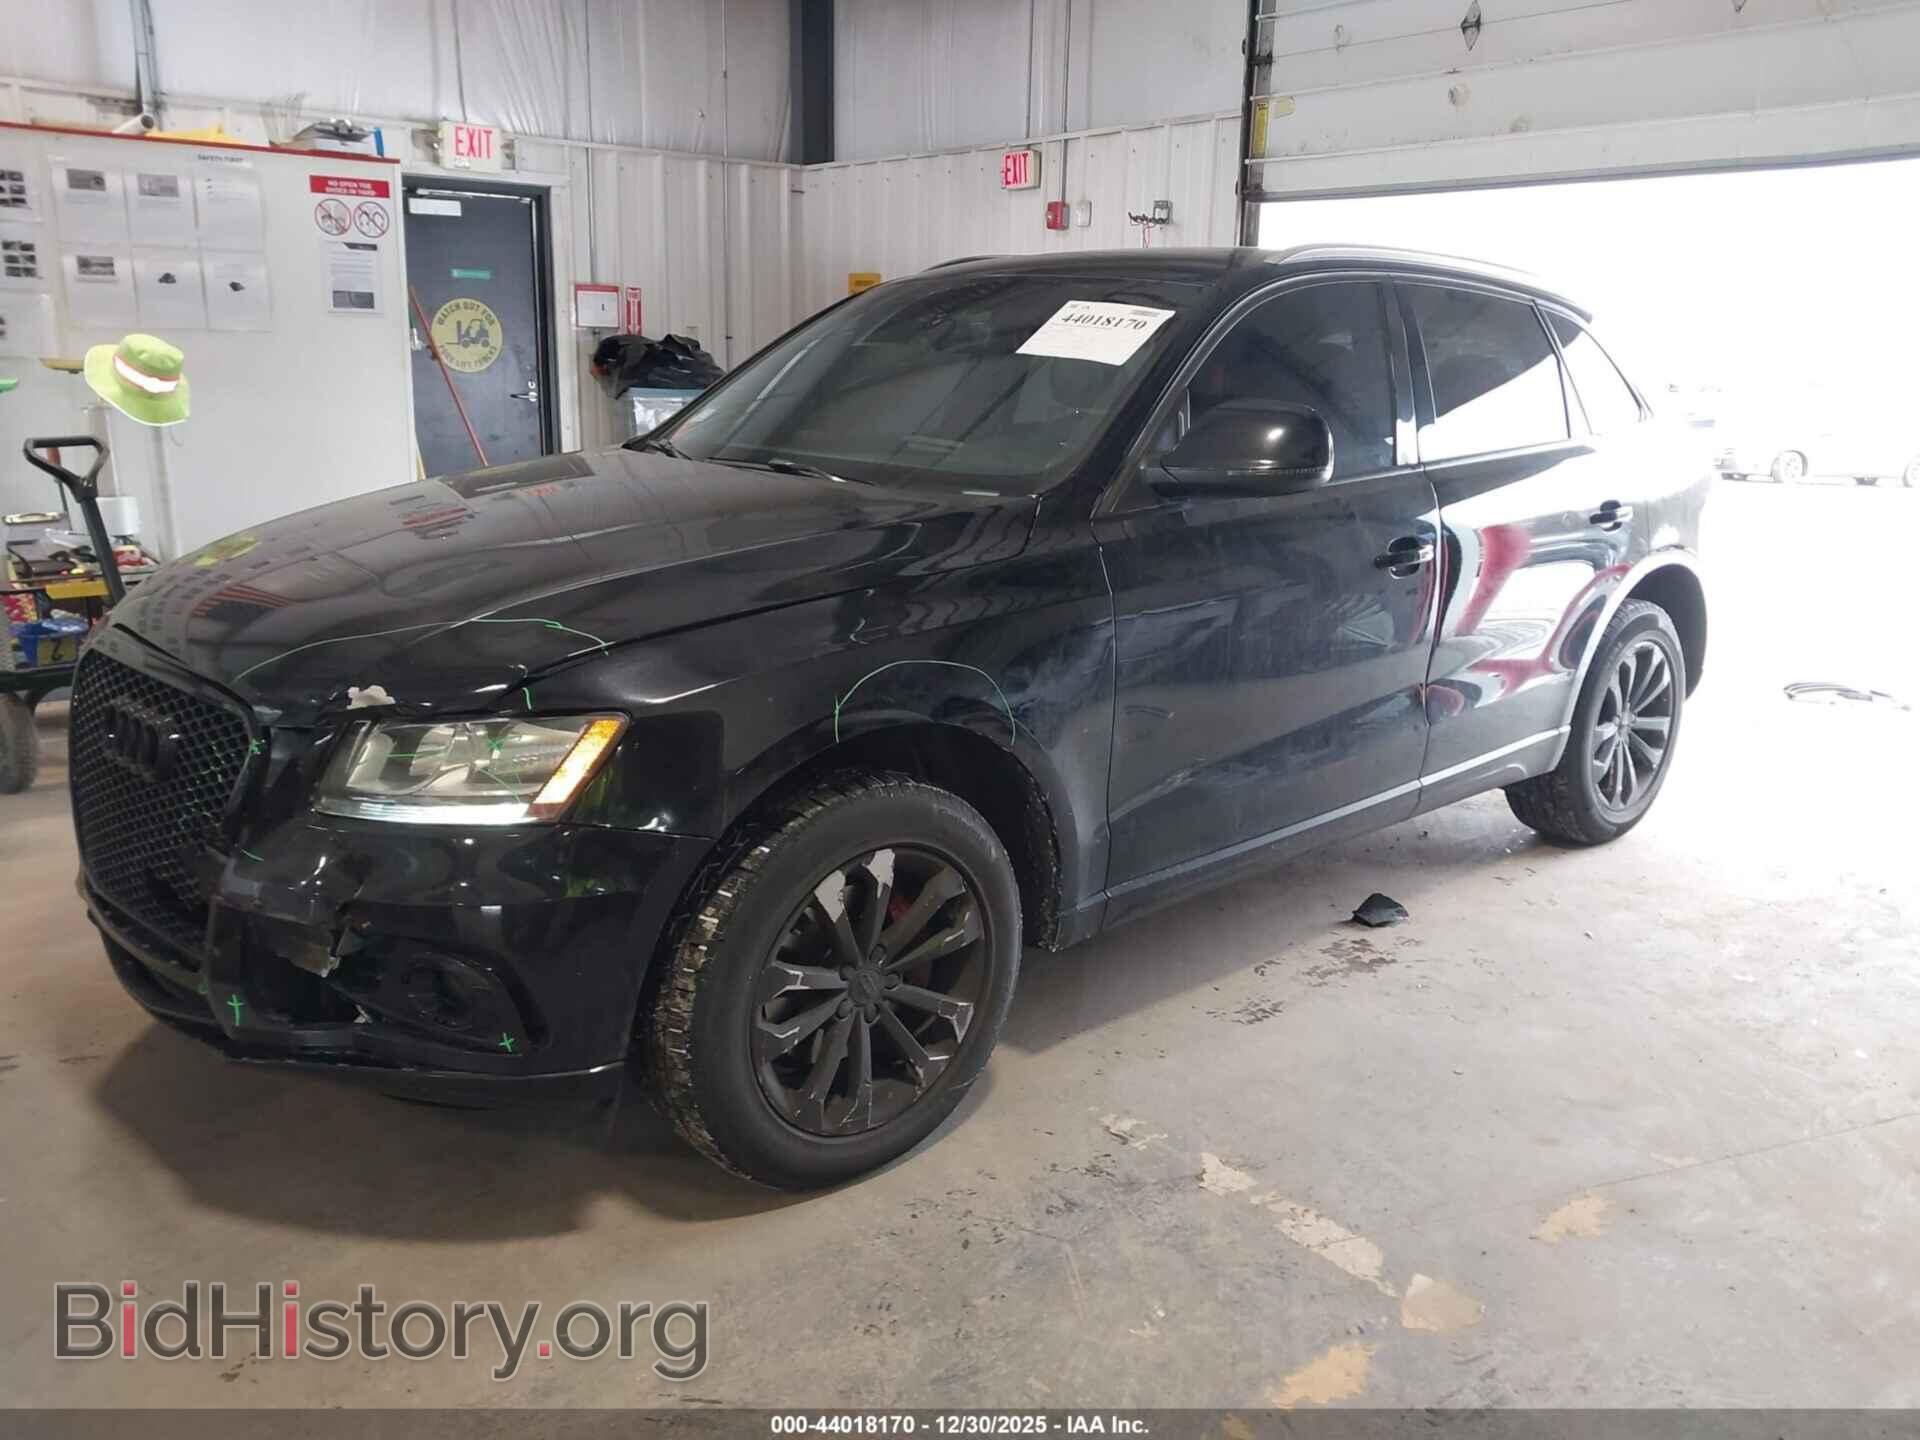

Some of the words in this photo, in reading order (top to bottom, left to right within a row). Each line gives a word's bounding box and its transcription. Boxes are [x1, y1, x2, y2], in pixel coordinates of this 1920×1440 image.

[455, 126, 493, 159] EXIT
[1005, 152, 1029, 185] EXIT
[437, 301, 461, 326] WATCH
[1061, 313, 1147, 330] 44018170
